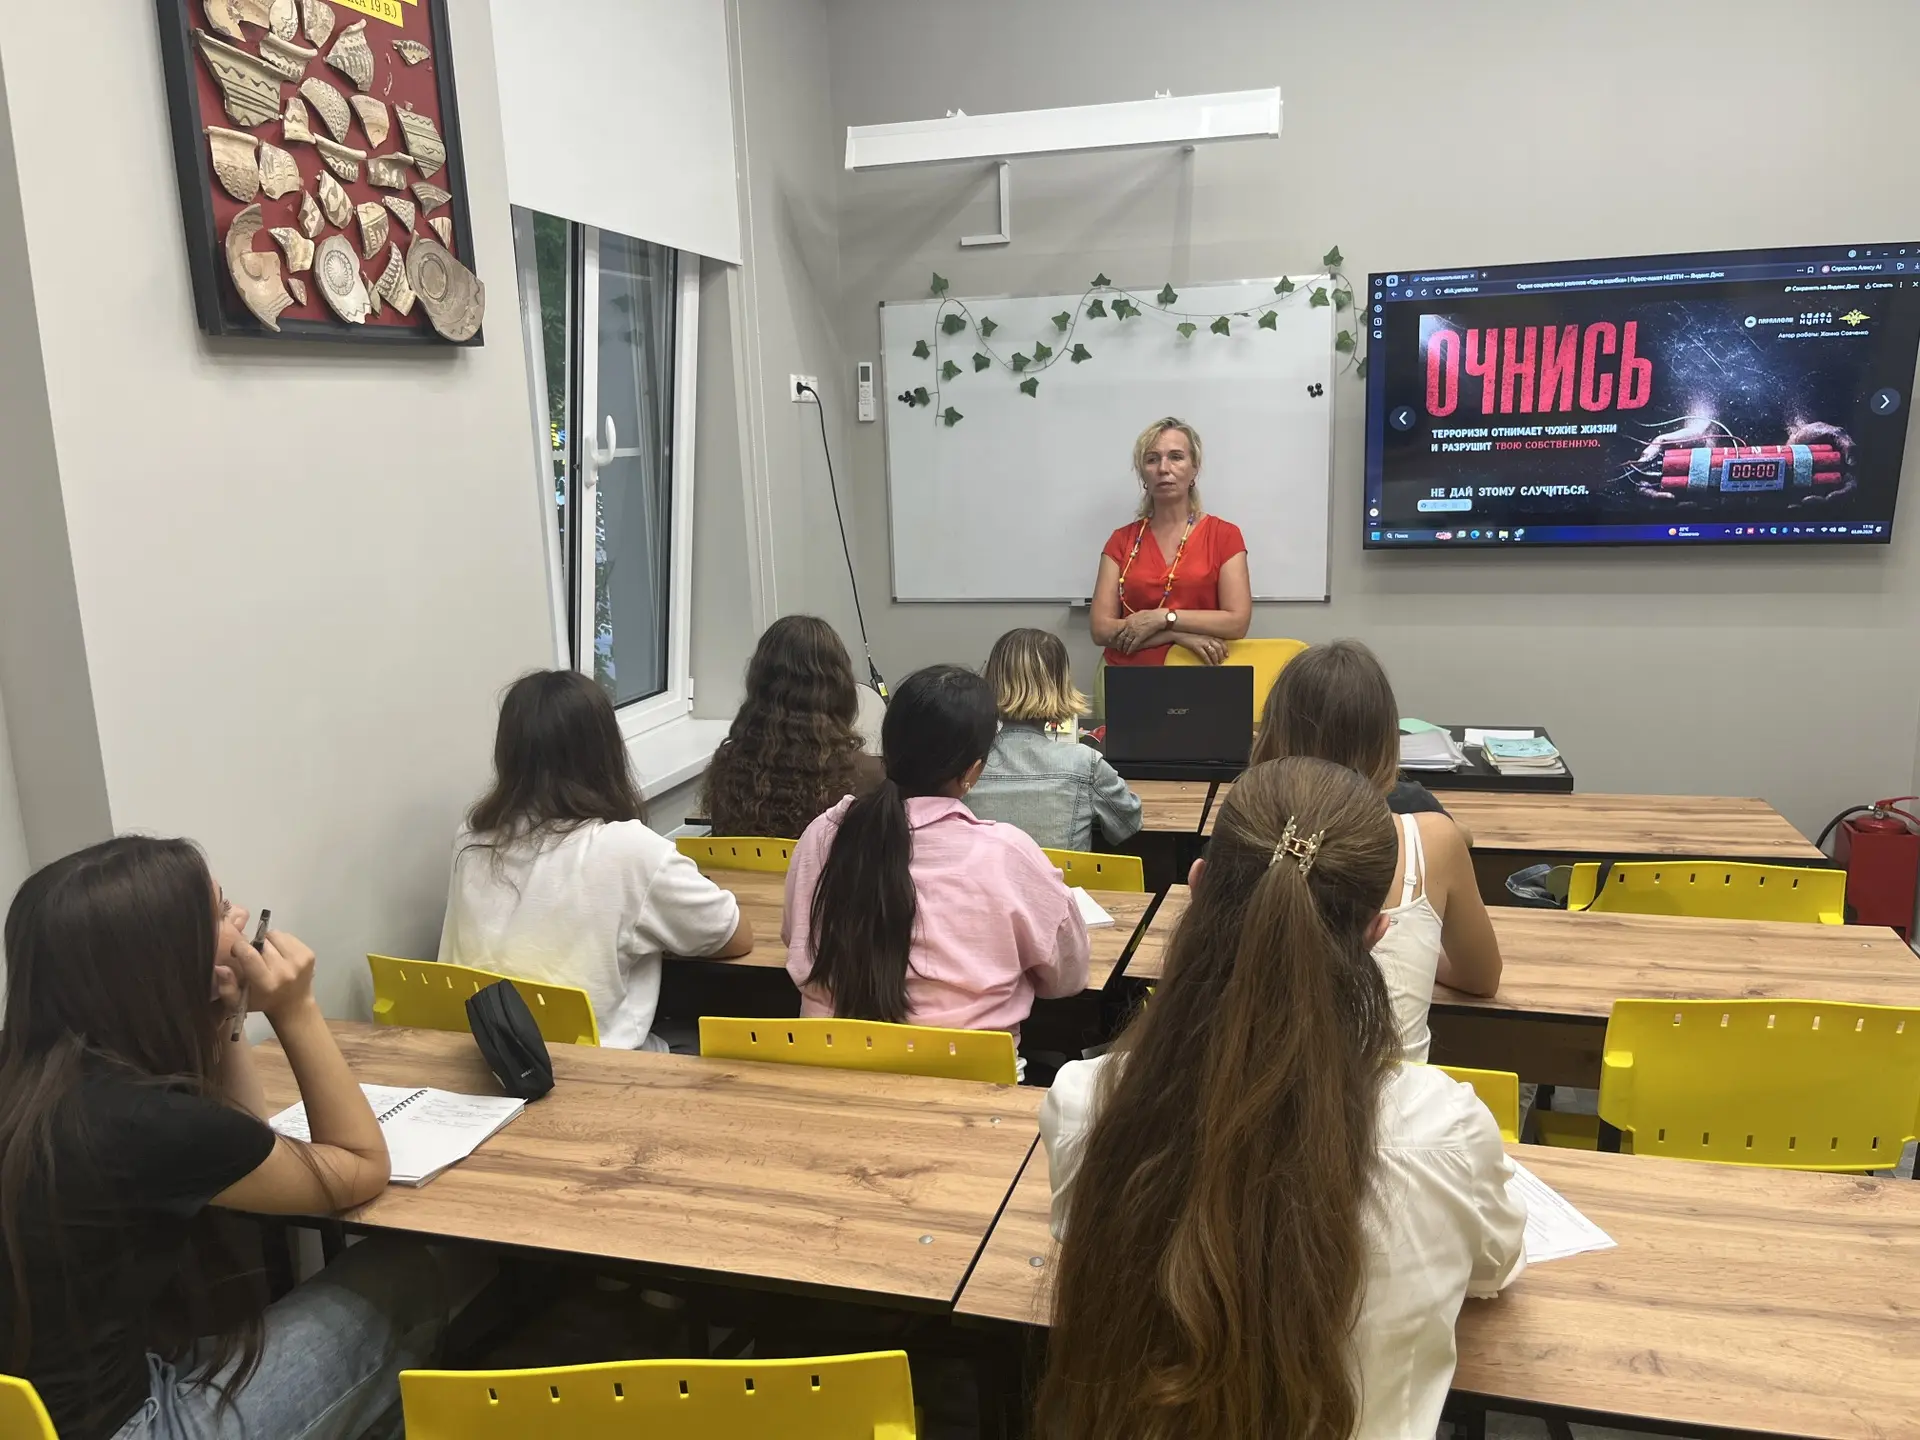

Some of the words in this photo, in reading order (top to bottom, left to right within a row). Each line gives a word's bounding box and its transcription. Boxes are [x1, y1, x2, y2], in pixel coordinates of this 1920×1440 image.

[1425, 320, 1652, 418] ОЧНИСЬ
[1431, 427, 1488, 438] ТЕРРОРИЗМ
[1491, 426, 1542, 437] ОТНИМАЕТ
[1544, 424, 1578, 436] ЧУЖИЕ
[1580, 423, 1617, 434] ЖИЗНИ
[1430, 443, 1438, 452] И
[1442, 441, 1492, 452] РАЗРУШИТ
[1495, 441, 1522, 450] ТВОЮ
[1525, 439, 1601, 449] СОБСТВЕННУЮ.
[1731, 464, 1776, 479] 00:00
[1430, 487, 1445, 498] НЕ
[1449, 485, 1473, 498] ДАЙ
[1478, 486, 1516, 497] ЭТОМУ
[1520, 485, 1589, 498] СЛУЧИТЬСЯ.
